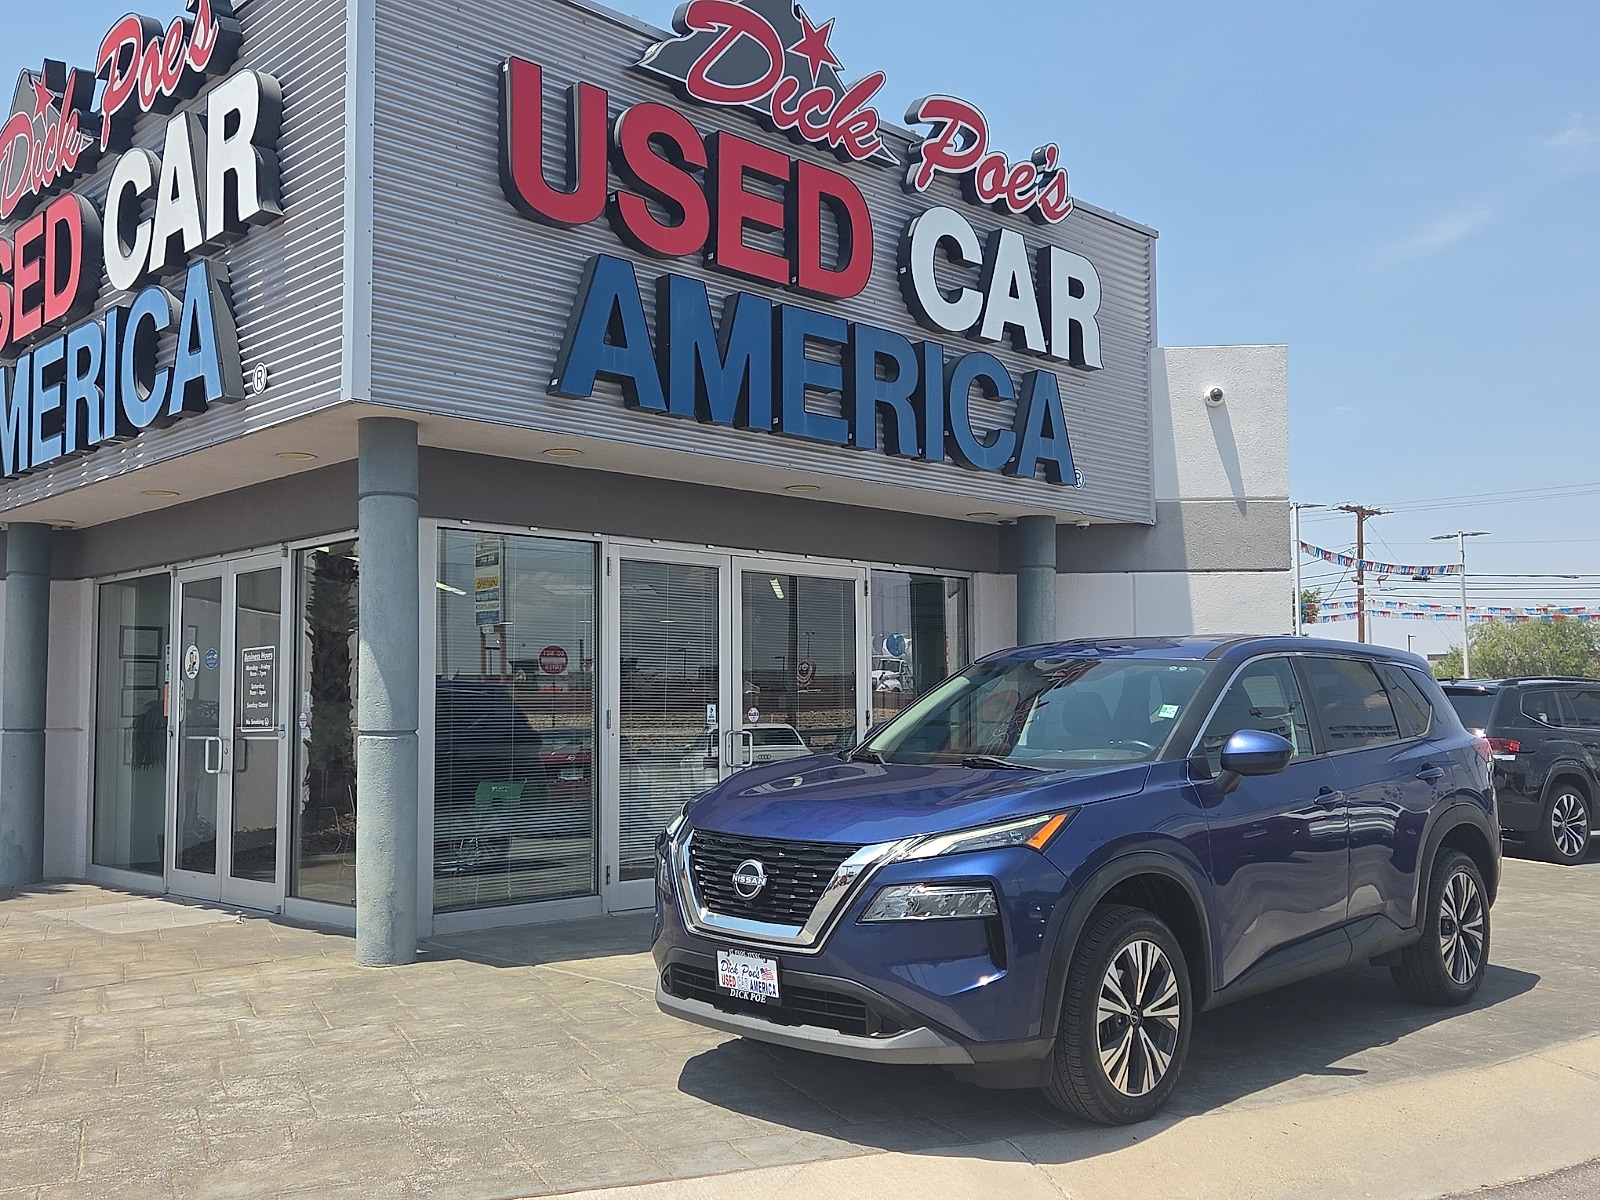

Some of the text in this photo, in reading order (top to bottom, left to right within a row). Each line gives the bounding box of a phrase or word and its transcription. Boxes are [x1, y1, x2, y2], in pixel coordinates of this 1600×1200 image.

[0, 69, 84, 220] Dick
[103, 68, 262, 292] CAR
[686, 0, 1074, 224] Dick Poe's
[503, 56, 1103, 370] USED CAR
[550, 254, 1077, 486] AMERICA
[732, 873, 767, 886] NISSAN
[721, 959, 760, 979] Dick Poe's
[721, 974, 737, 988] USED
[750, 980, 777, 996] AMERICA
[730, 988, 767, 1004] DICK POE
